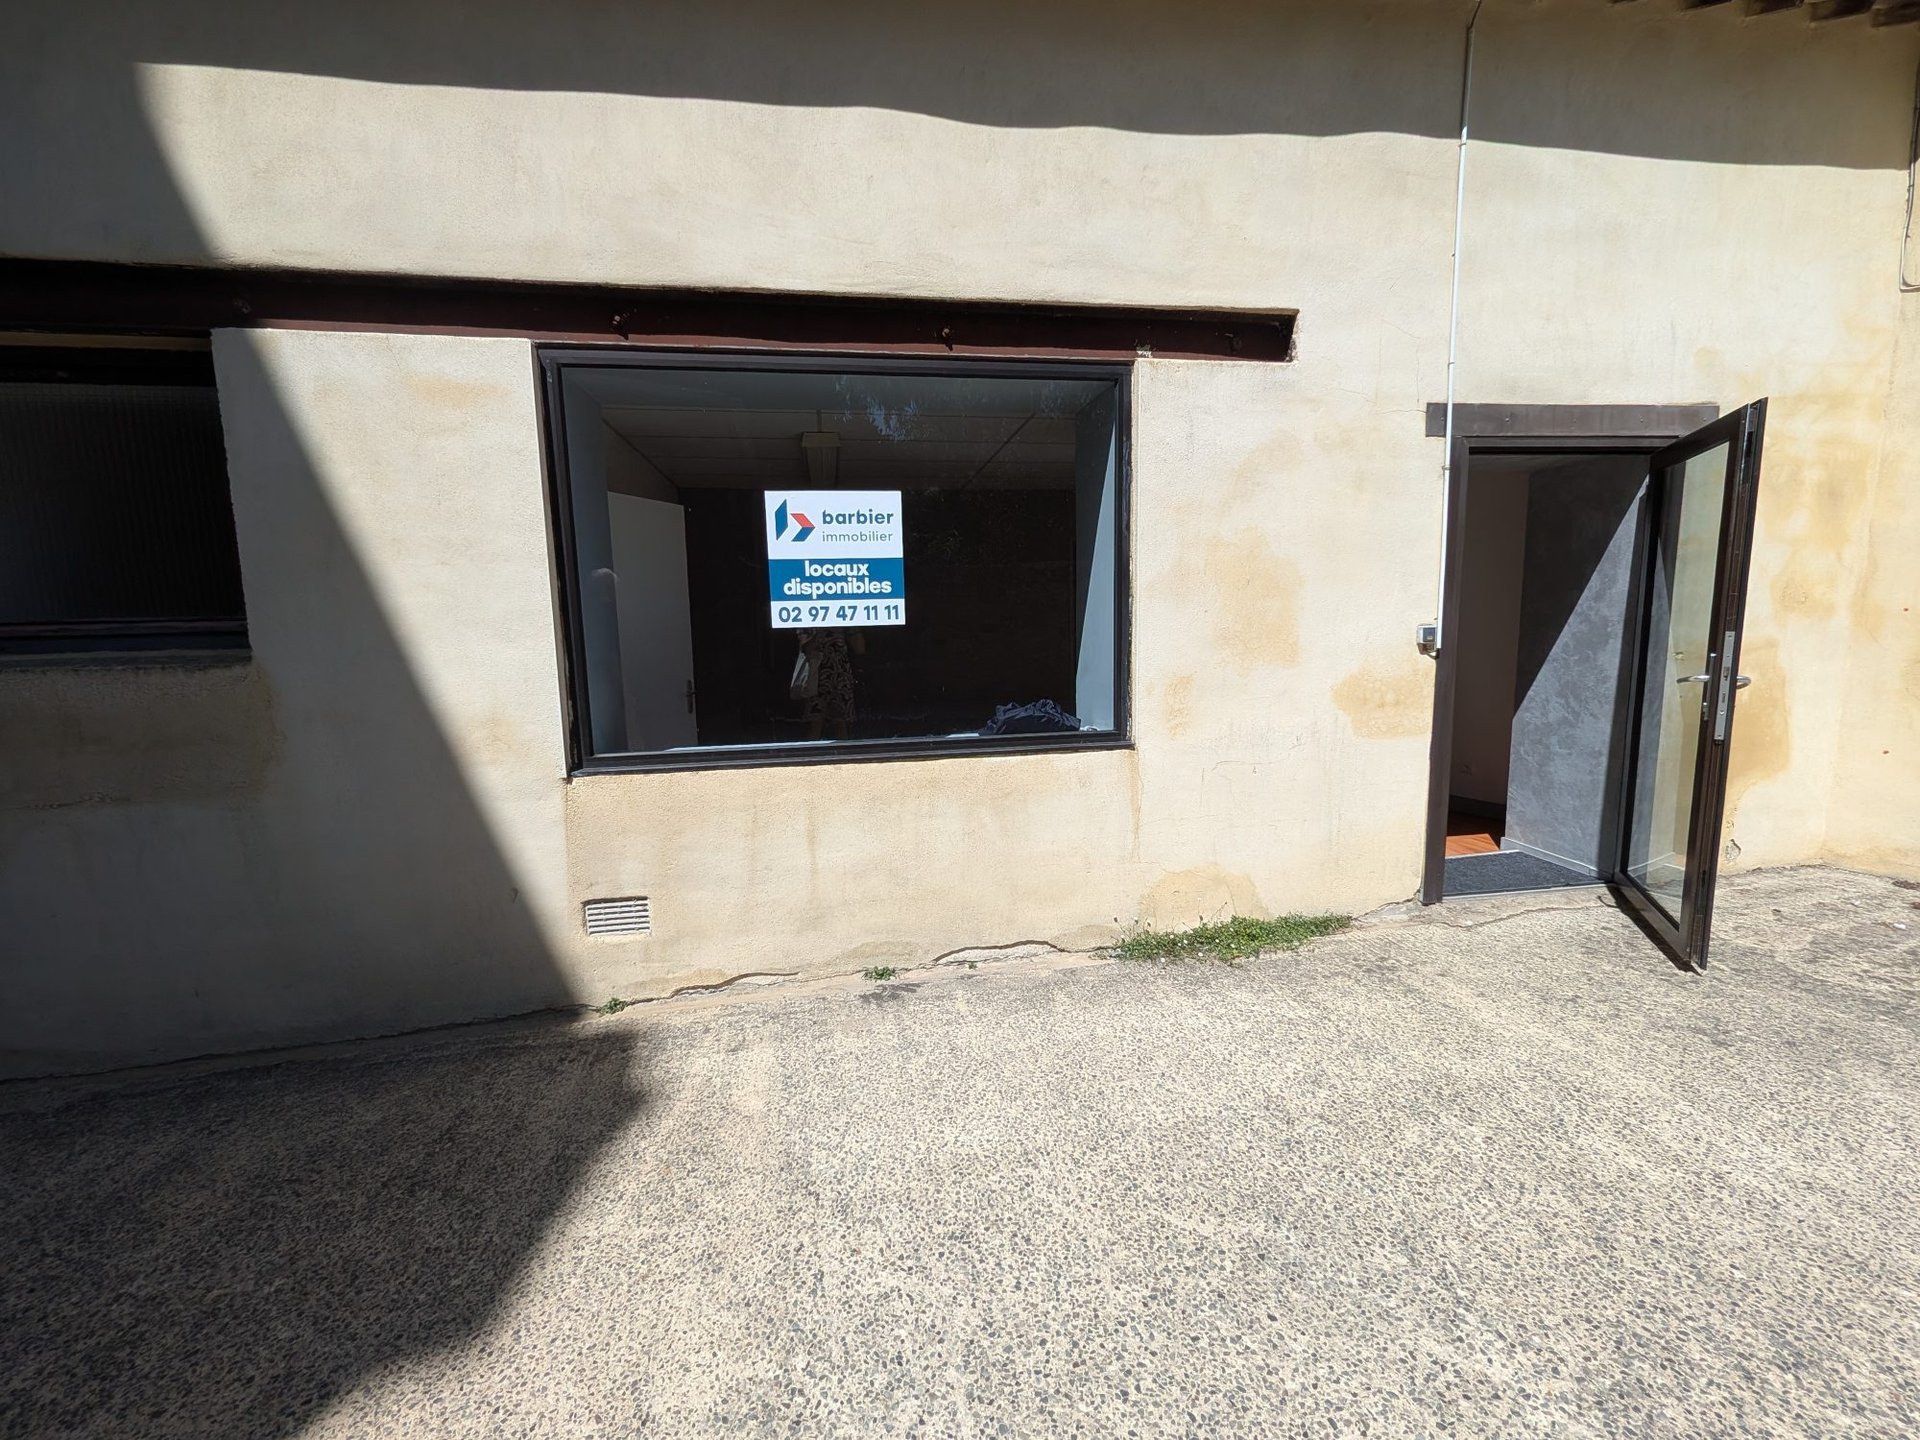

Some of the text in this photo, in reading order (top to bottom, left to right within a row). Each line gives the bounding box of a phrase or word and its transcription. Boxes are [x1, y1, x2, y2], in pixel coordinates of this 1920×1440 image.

[822, 508, 894, 525] barbier
[822, 531, 893, 542] immobilier
[804, 560, 869, 577] locaux
[783, 577, 892, 600] disponibles
[778, 604, 899, 623] 02 97 47 11 11
